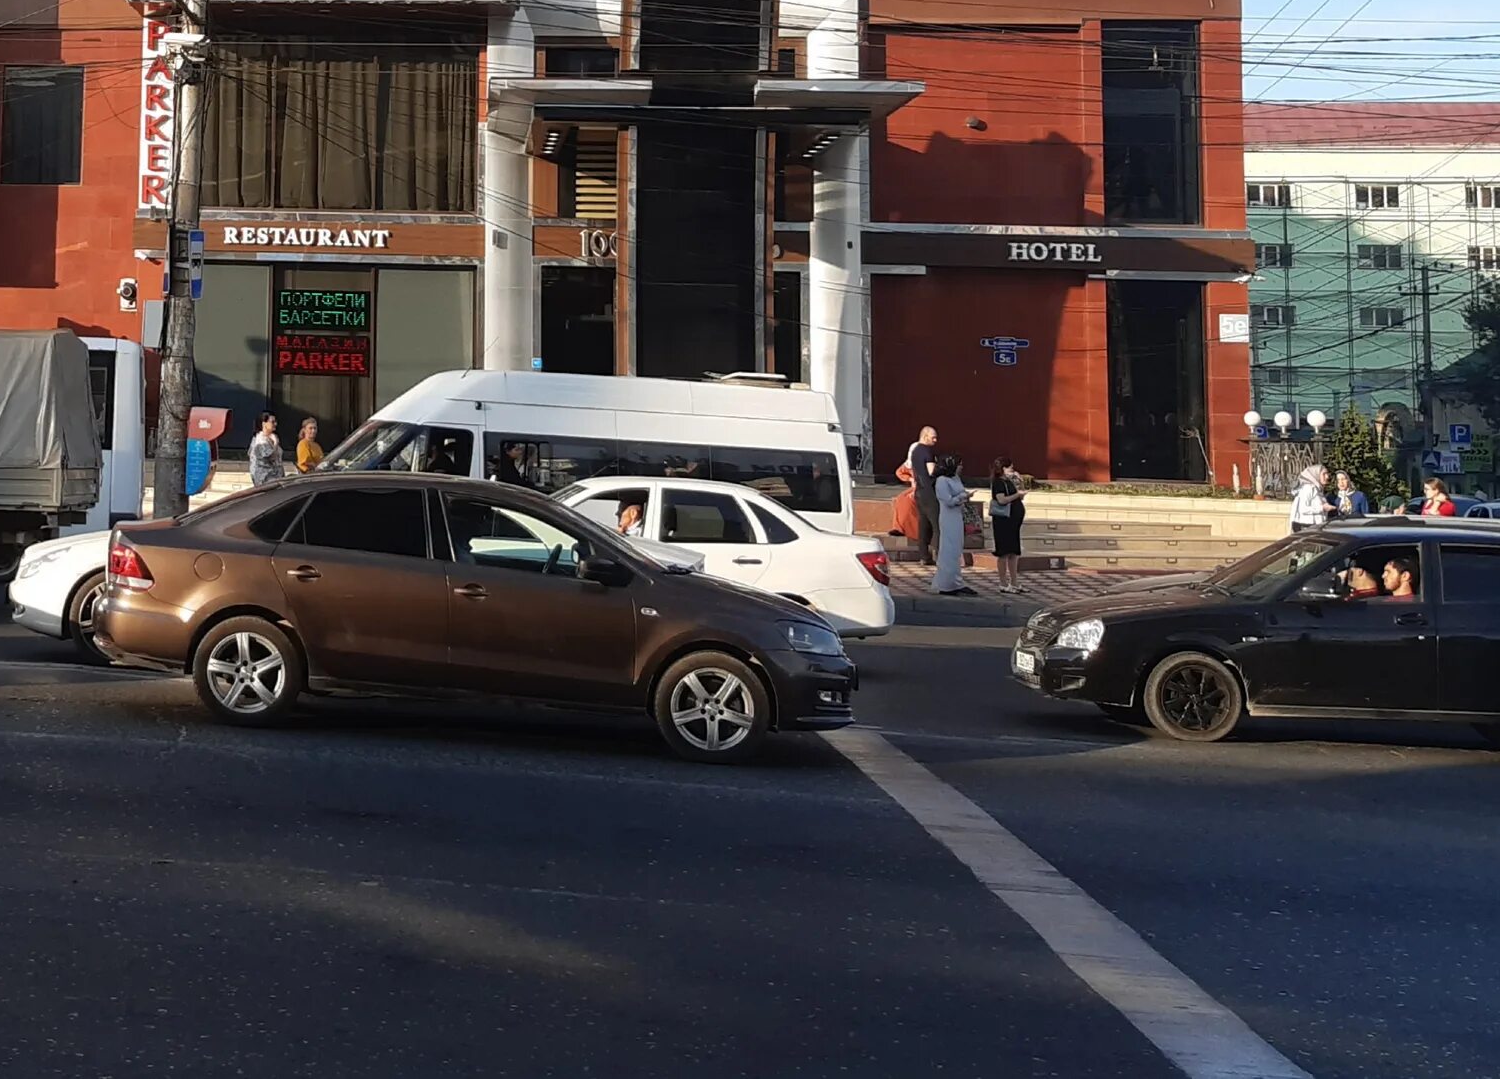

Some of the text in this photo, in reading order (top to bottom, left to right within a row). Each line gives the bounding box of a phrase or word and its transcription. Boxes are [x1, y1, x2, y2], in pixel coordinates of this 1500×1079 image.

[141, 21, 173, 204] PARKER
[224, 227, 390, 248] RESTAURANT
[1008, 242, 1102, 263] HOTEL
[279, 291, 366, 308] ПОРТФЕЛИ
[279, 309, 366, 326] БАРСЕТКИ
[279, 351, 366, 371] PARKER
